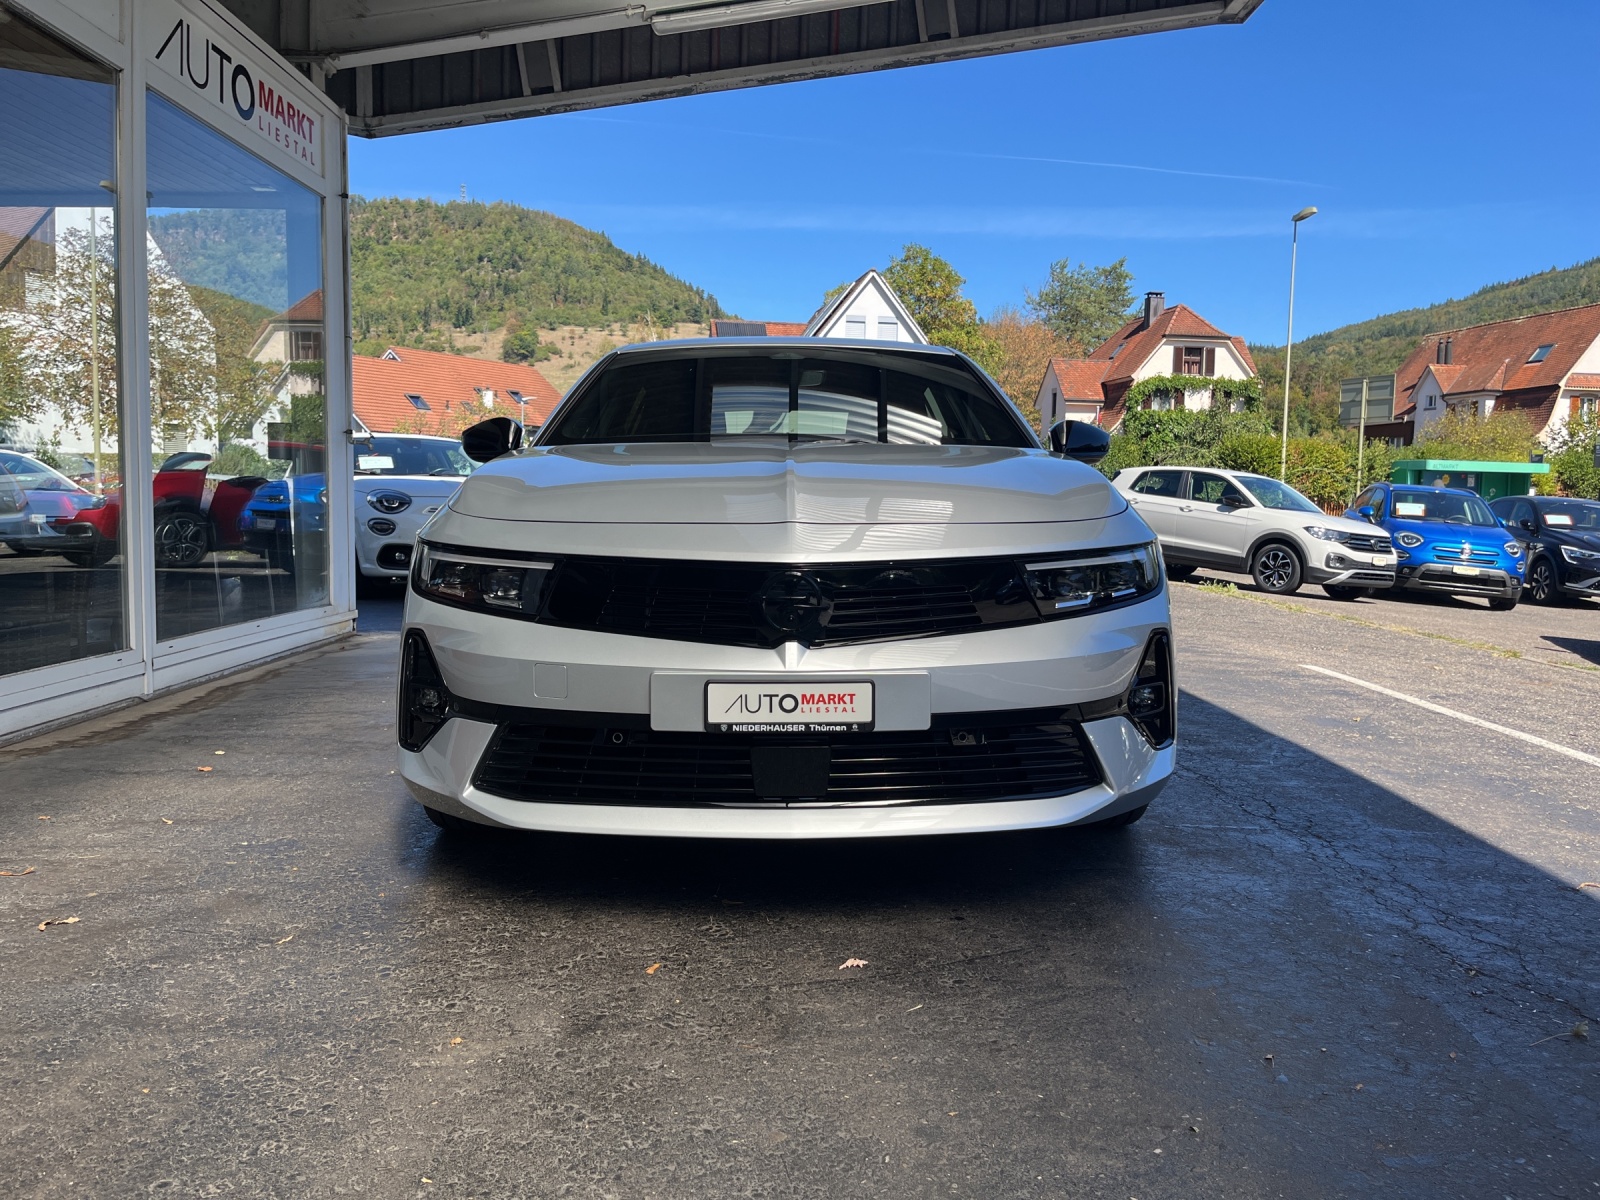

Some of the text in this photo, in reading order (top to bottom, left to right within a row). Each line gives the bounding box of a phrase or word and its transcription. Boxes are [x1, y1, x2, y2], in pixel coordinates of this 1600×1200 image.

[155, 19, 315, 145] AUTO MARKT
[258, 115, 315, 166] LIESTAL
[724, 694, 856, 714] AUTO MARKT
[732, 723, 847, 732] NIEDERHAUSER Thürnen
